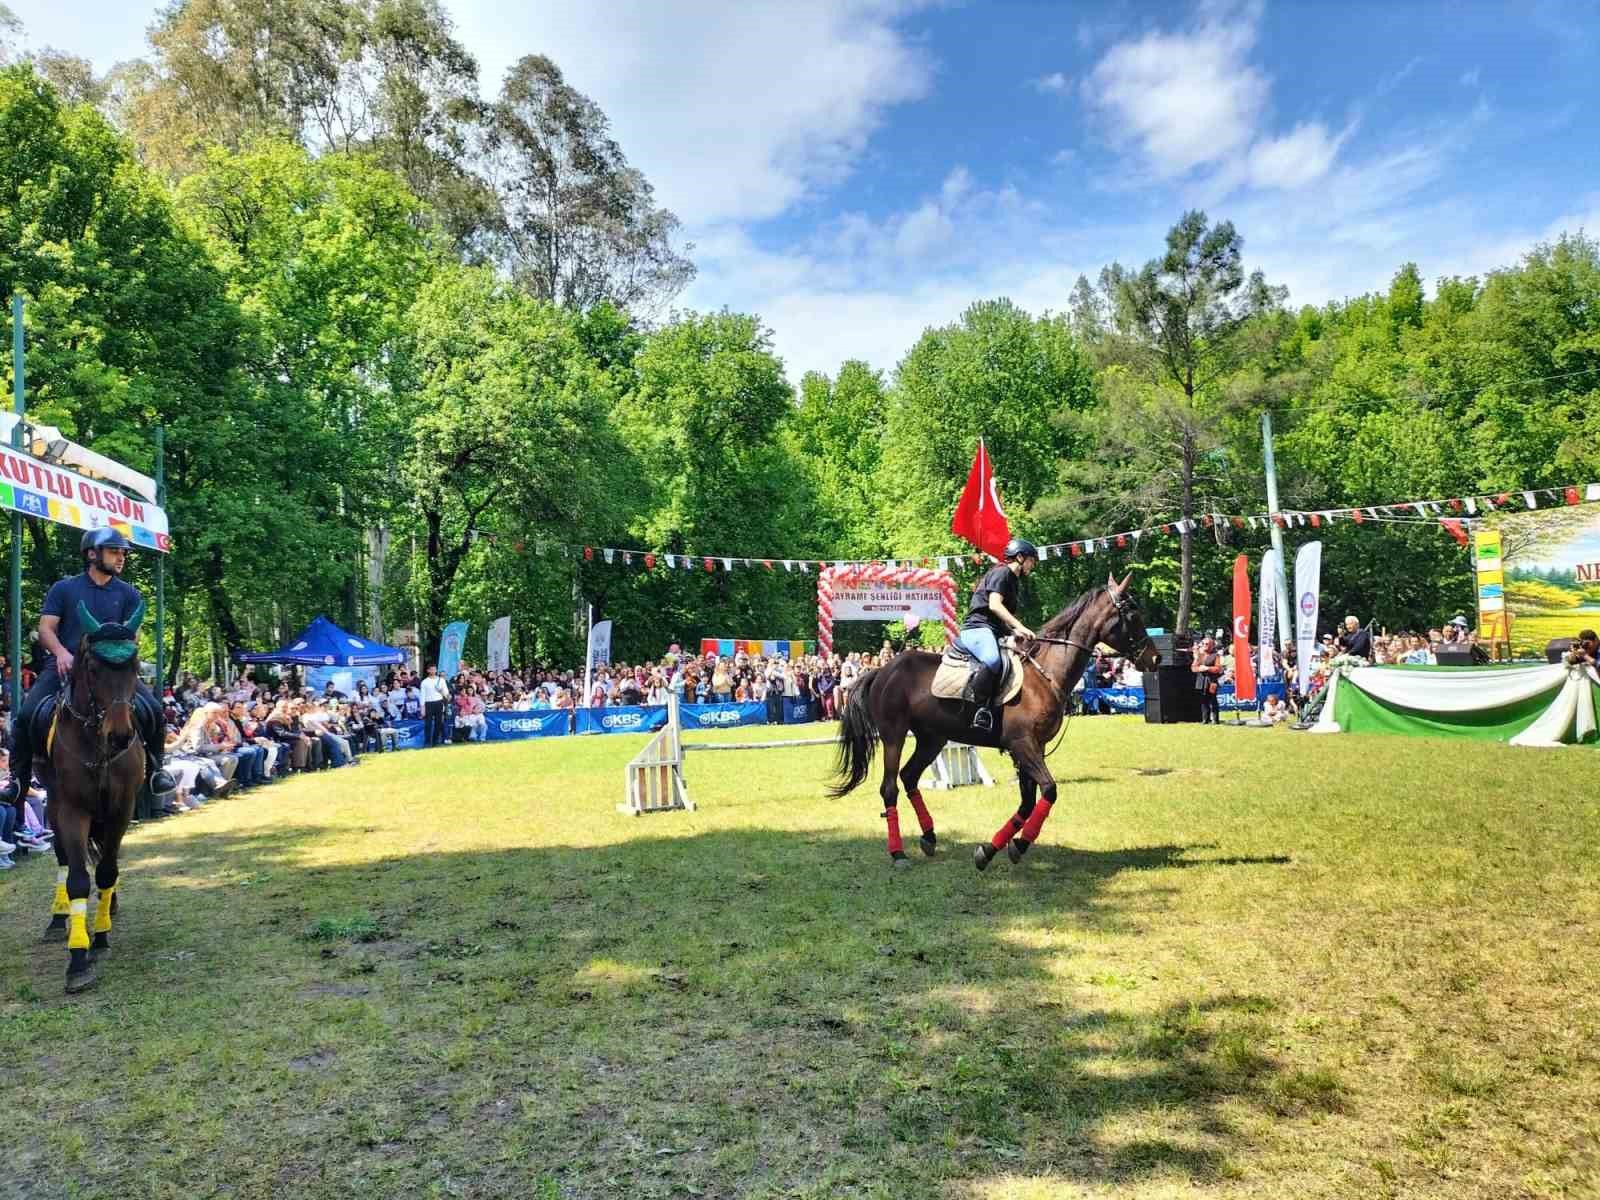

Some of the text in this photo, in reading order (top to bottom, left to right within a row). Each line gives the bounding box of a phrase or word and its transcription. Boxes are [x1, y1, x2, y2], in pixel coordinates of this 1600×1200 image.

[78, 482, 145, 523] OLSUN
[511, 718, 542, 729] KBS
[613, 713, 641, 725] KBS
